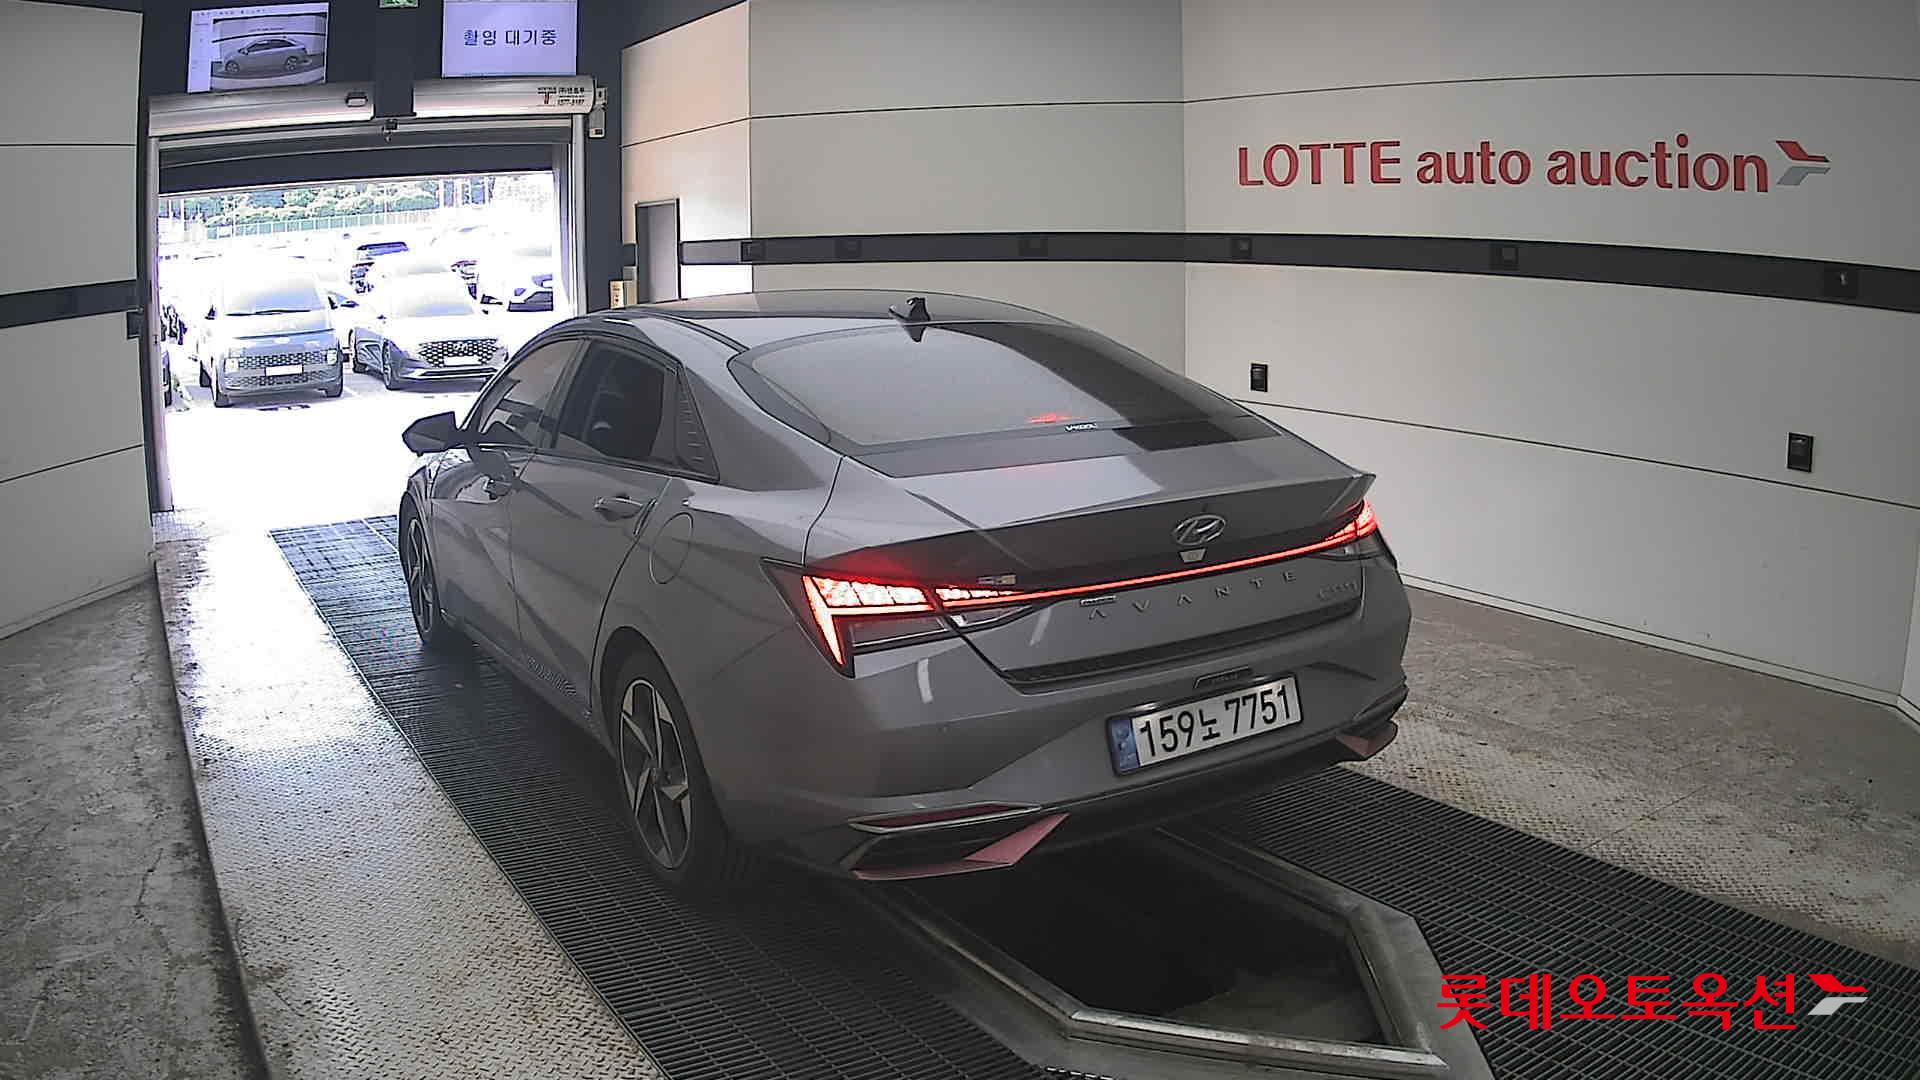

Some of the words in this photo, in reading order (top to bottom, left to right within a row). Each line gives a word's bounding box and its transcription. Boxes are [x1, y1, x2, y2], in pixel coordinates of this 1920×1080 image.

[505, 29, 557, 46] 대기중
[1238, 140, 1401, 188] LOTTE
[1416, 141, 1532, 185] auto
[1546, 133, 1769, 193] auction
[1089, 571, 1296, 620] AVANTE
[1139, 708, 1221, 758] 159노
[1224, 684, 1291, 735] 7751
